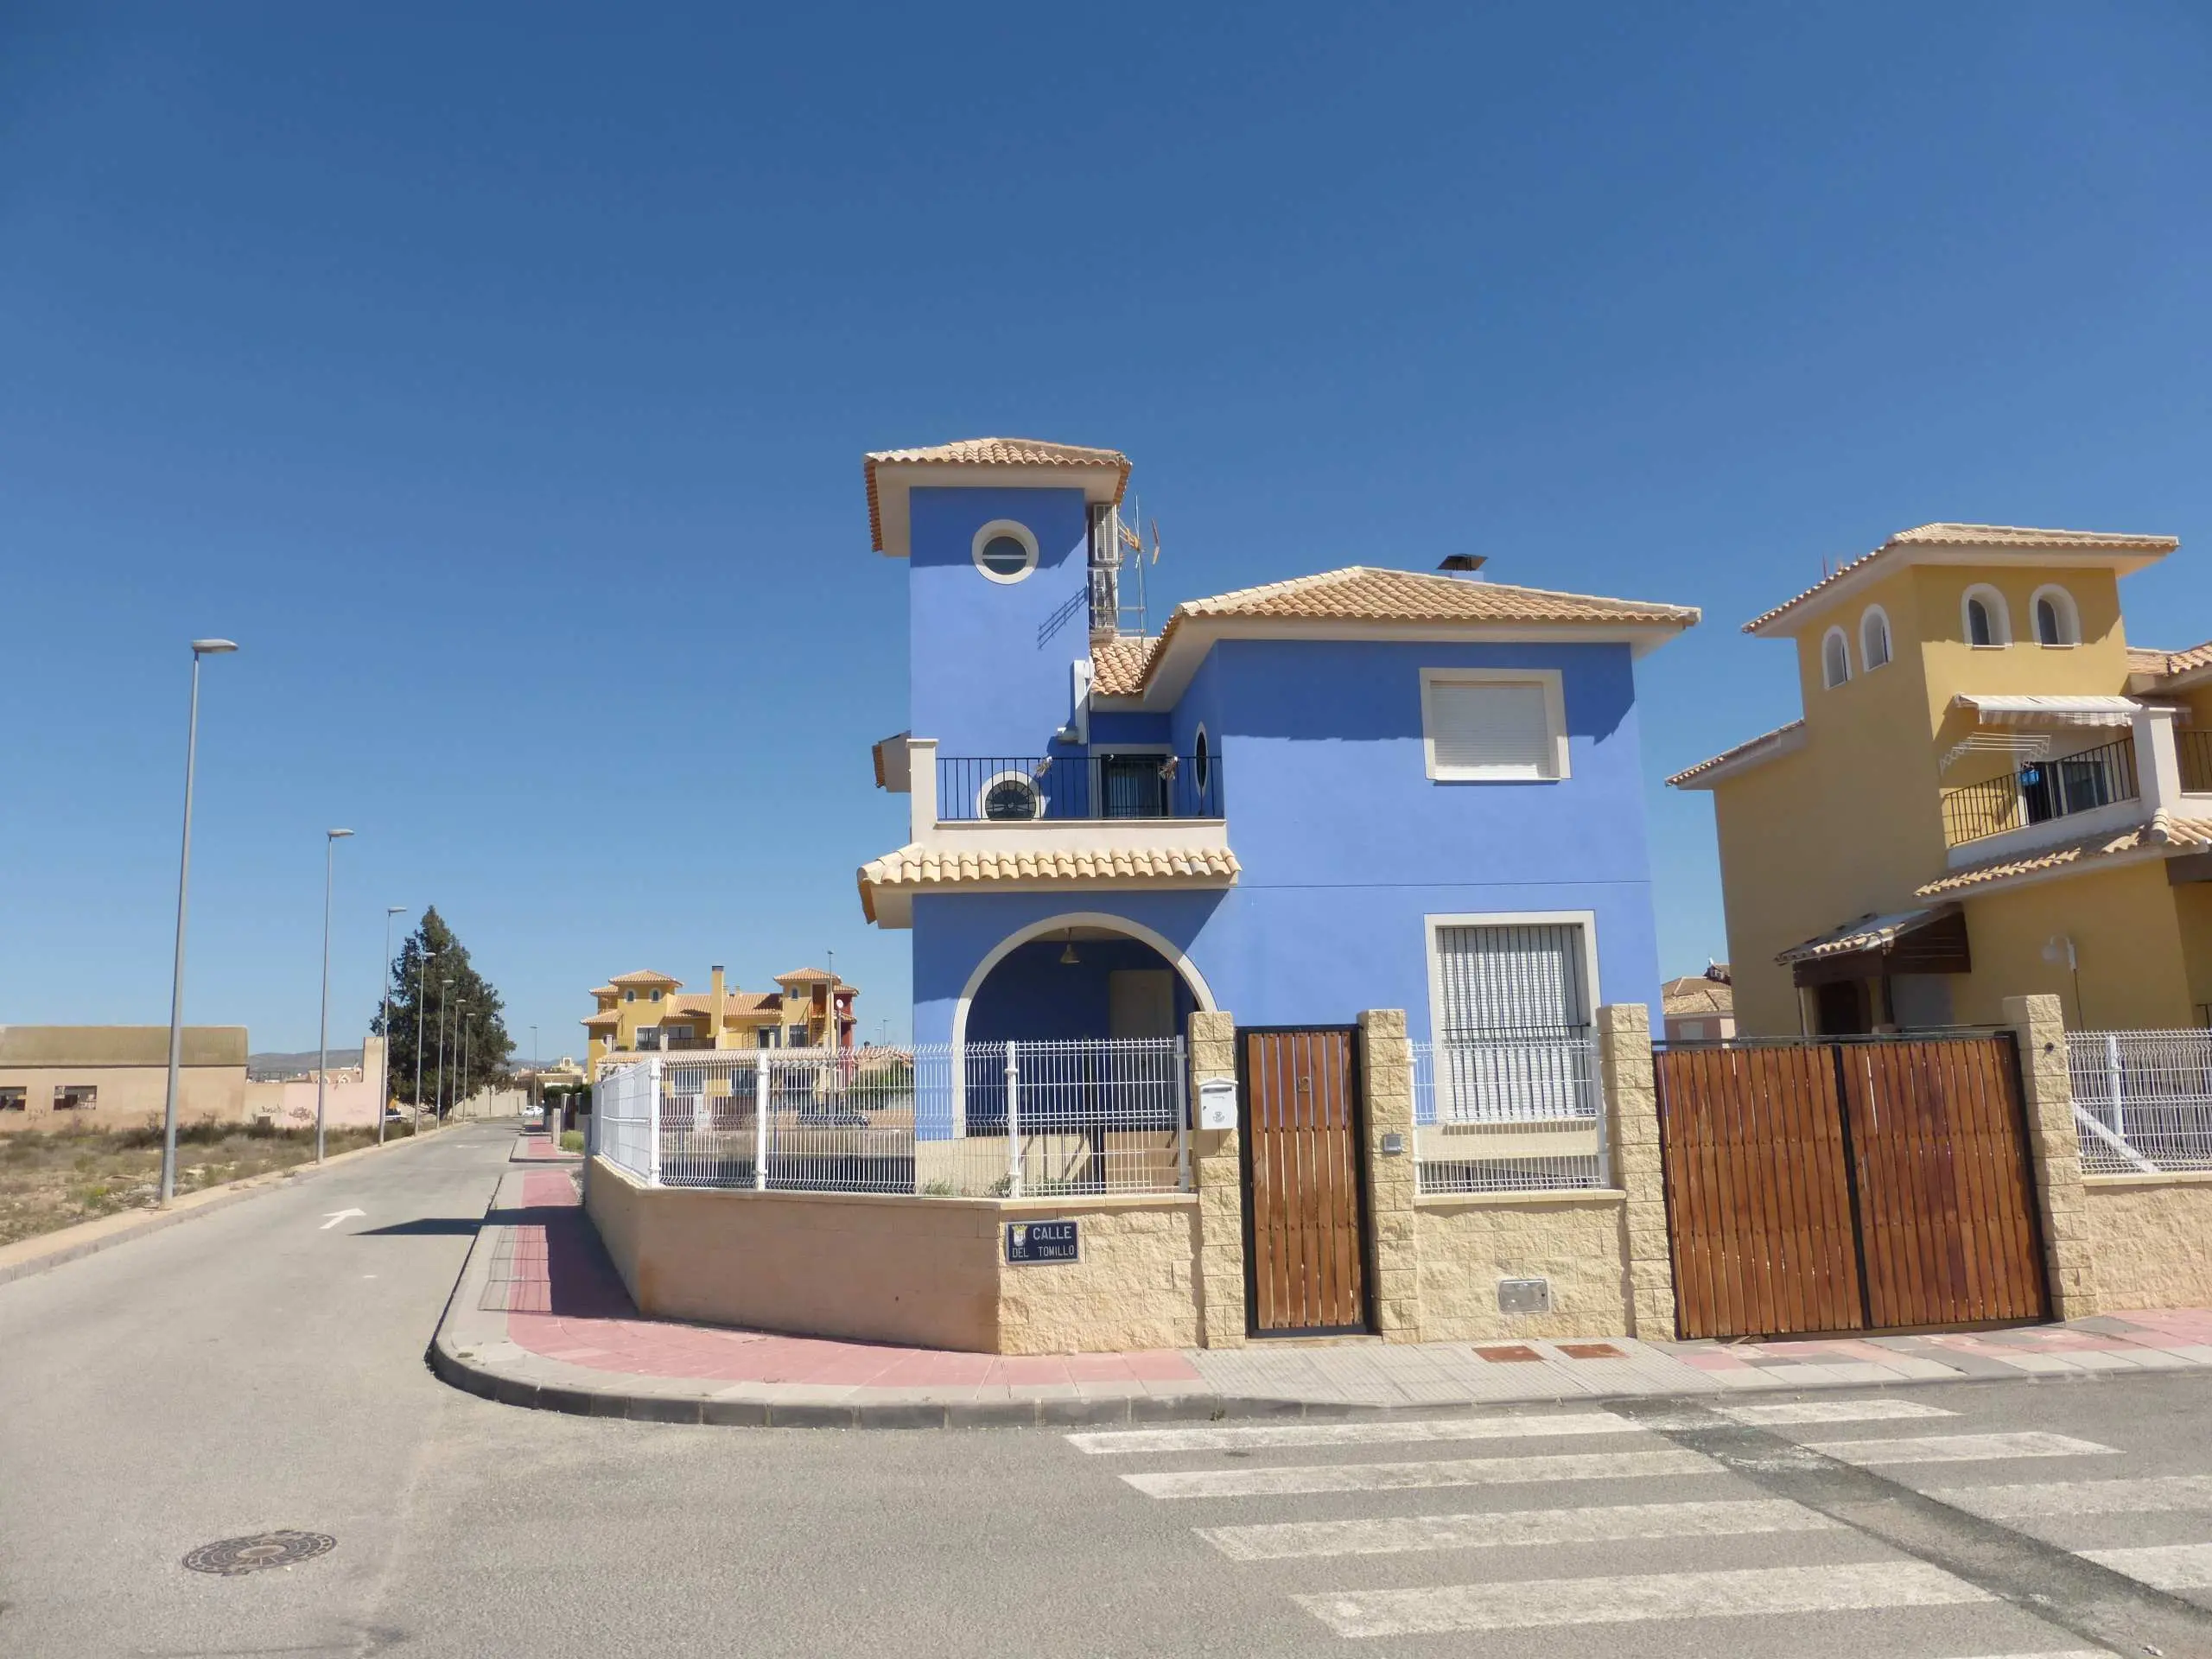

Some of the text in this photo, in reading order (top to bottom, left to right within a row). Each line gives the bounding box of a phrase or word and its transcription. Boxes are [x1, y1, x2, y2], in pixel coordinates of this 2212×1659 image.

[1033, 1226, 1071, 1240] CALLE
[1012, 1245, 1074, 1258] DEL TOMILLO
